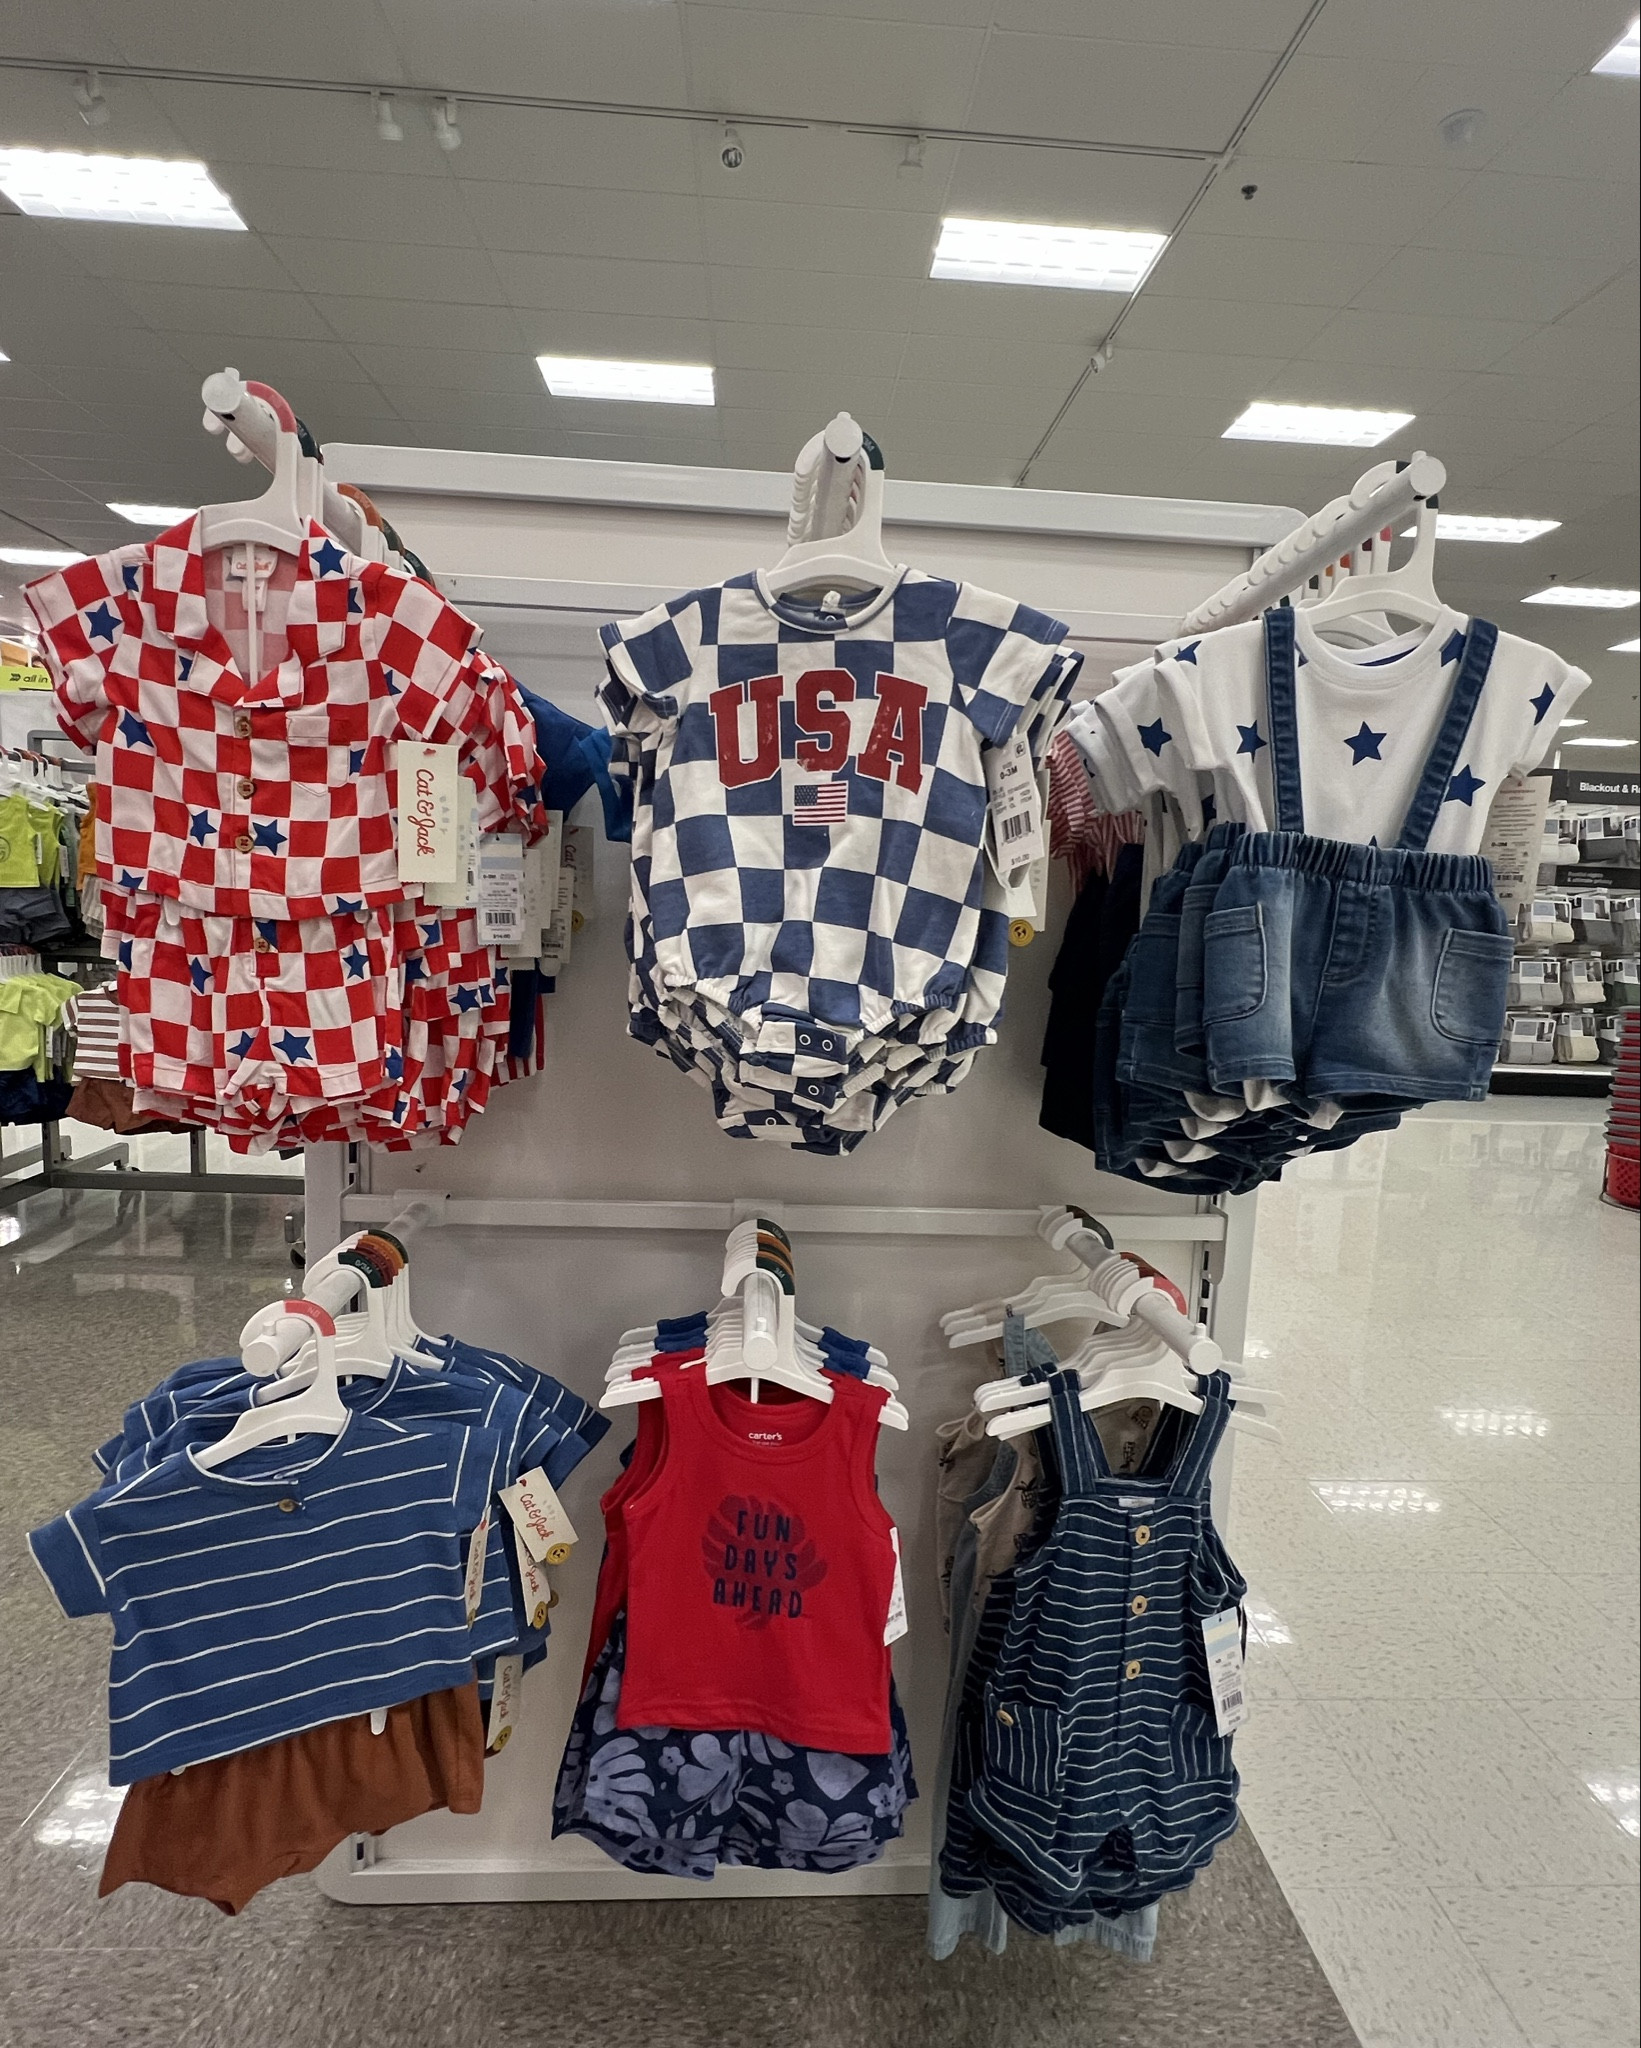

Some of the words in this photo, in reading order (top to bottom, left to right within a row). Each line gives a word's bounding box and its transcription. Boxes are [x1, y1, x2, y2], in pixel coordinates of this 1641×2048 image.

[23, 674, 37, 683] all
[708, 668, 929, 796] USA
[416, 768, 435, 798] Cat
[1000, 765, 1019, 780] 0-3M
[1579, 781, 1621, 794] Blackout
[1621, 784, 1629, 794] &
[416, 799, 435, 817] &
[407, 814, 436, 857] Jack
[748, 1432, 783, 1441] carter's
[520, 1493, 535, 1512] Cat
[528, 1508, 541, 1520] &
[526, 1517, 555, 1541] Jack
[737, 1510, 790, 1543] FUN
[724, 1544, 798, 1581] DAYS
[713, 1577, 803, 1619] AHEAD
